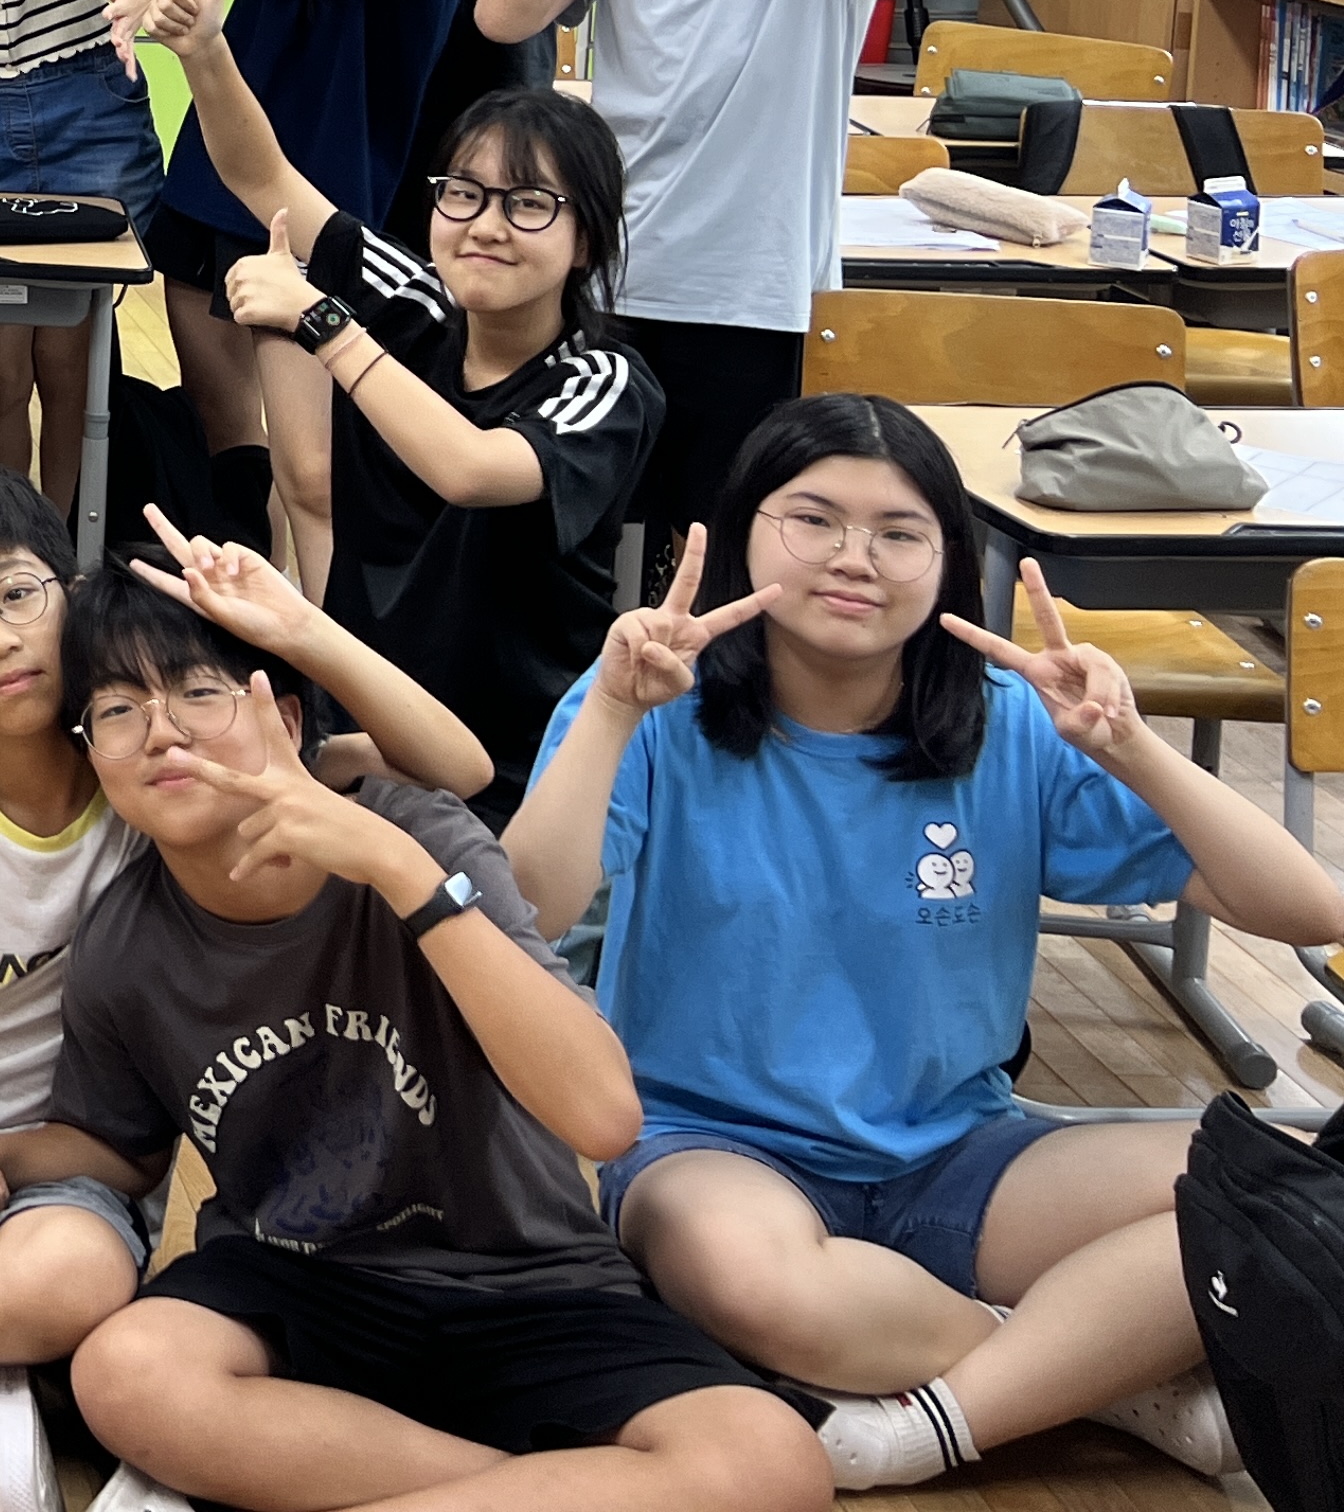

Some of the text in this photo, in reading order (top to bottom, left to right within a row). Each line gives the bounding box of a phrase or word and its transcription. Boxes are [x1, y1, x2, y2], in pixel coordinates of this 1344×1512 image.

[914, 901, 982, 927] 오손도손
[188, 1002, 438, 1154] MEXICAN FRIENDS
